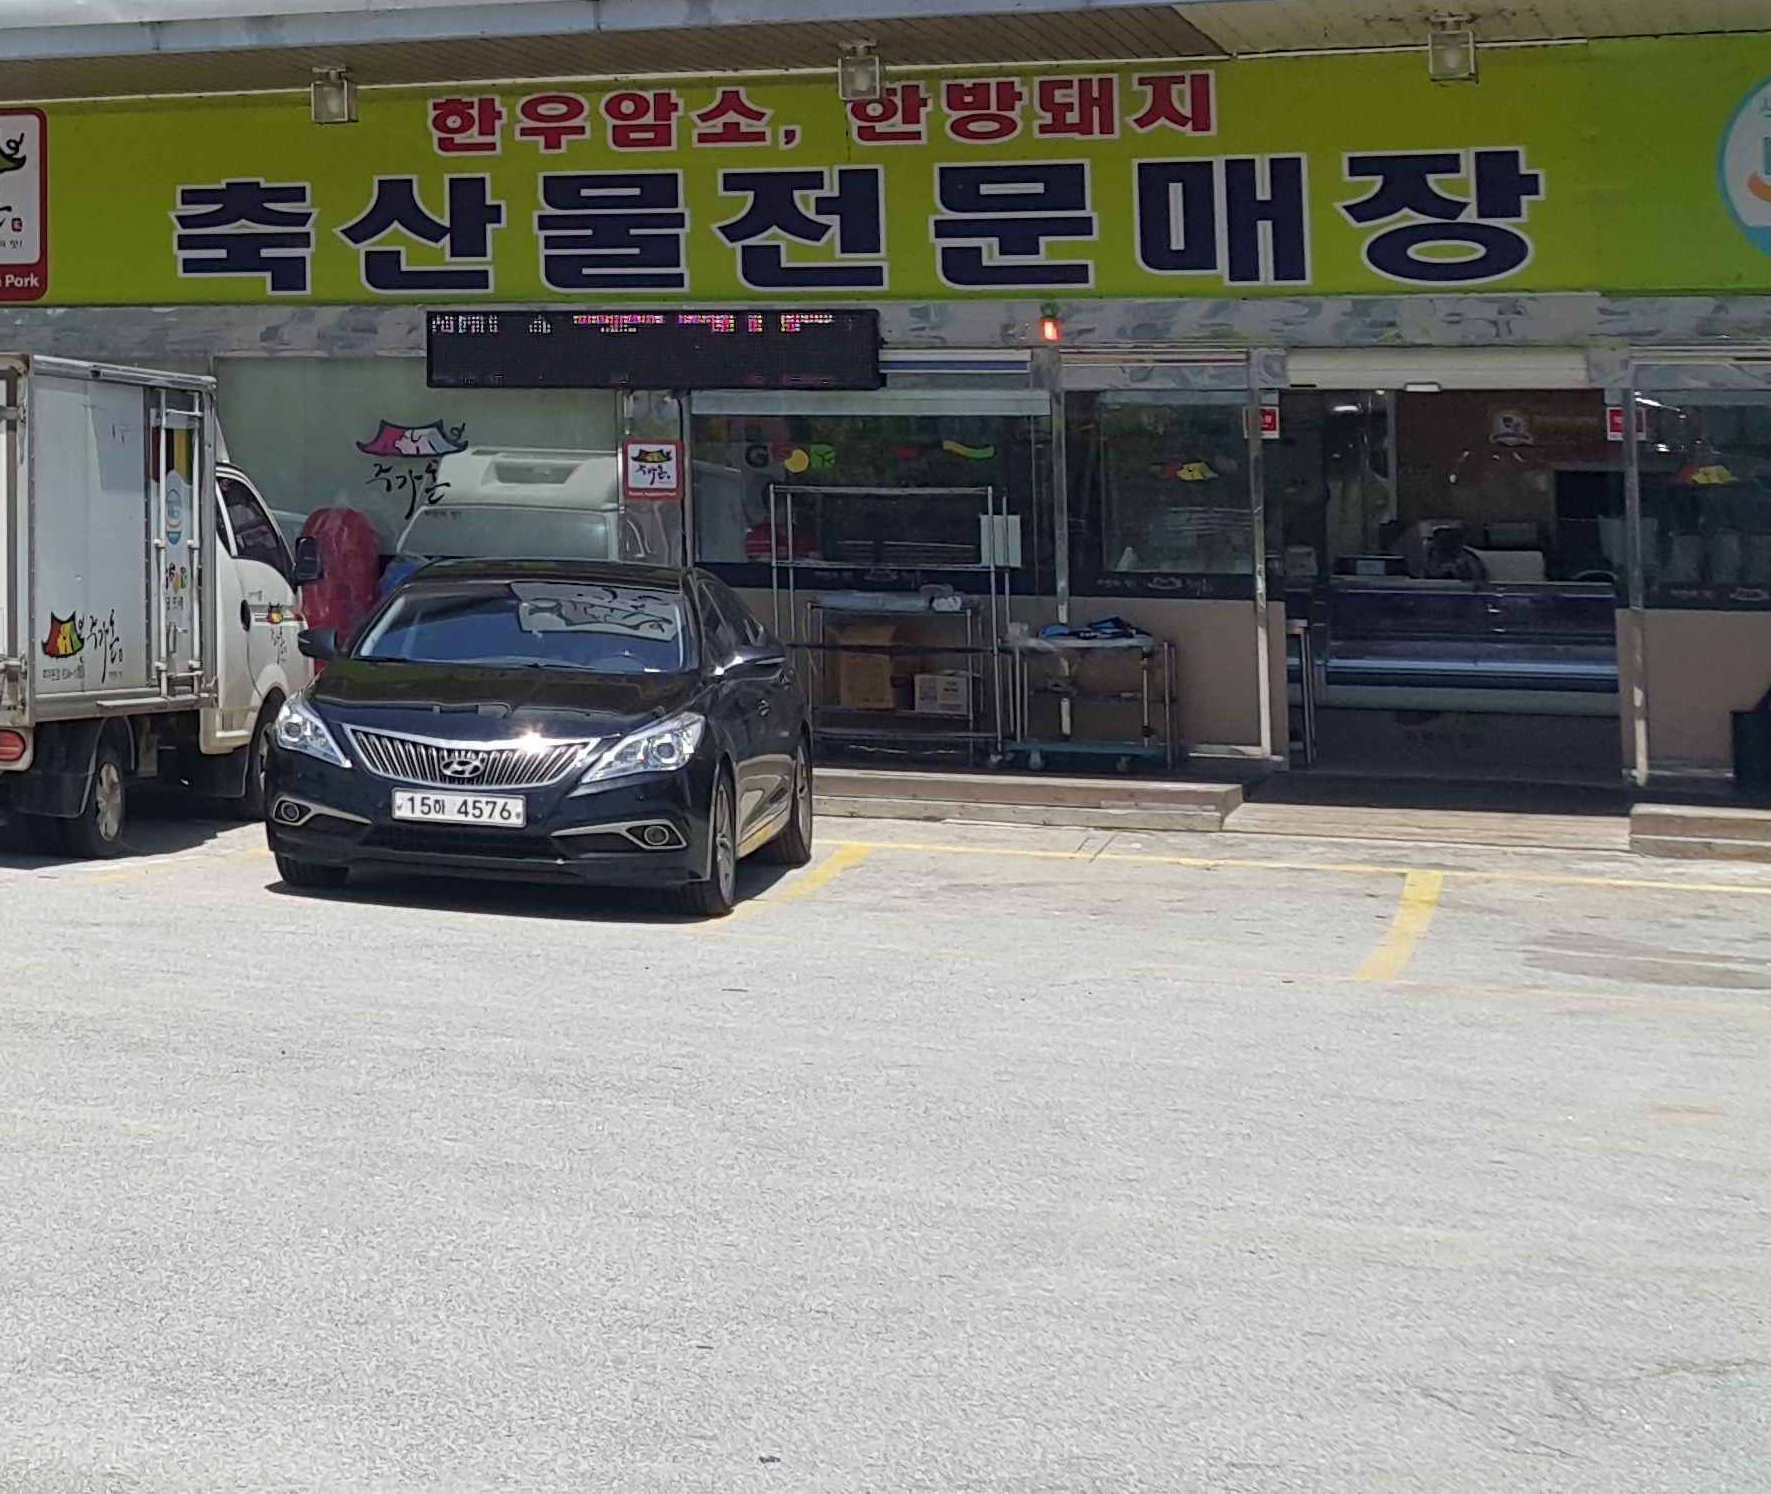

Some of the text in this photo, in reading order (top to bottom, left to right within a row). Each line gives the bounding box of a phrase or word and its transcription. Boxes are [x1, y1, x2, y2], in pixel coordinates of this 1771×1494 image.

[847, 70, 1217, 146] 한방돼지
[5, 273, 39, 288] Pork
[406, 795, 512, 820] 15하 4576
